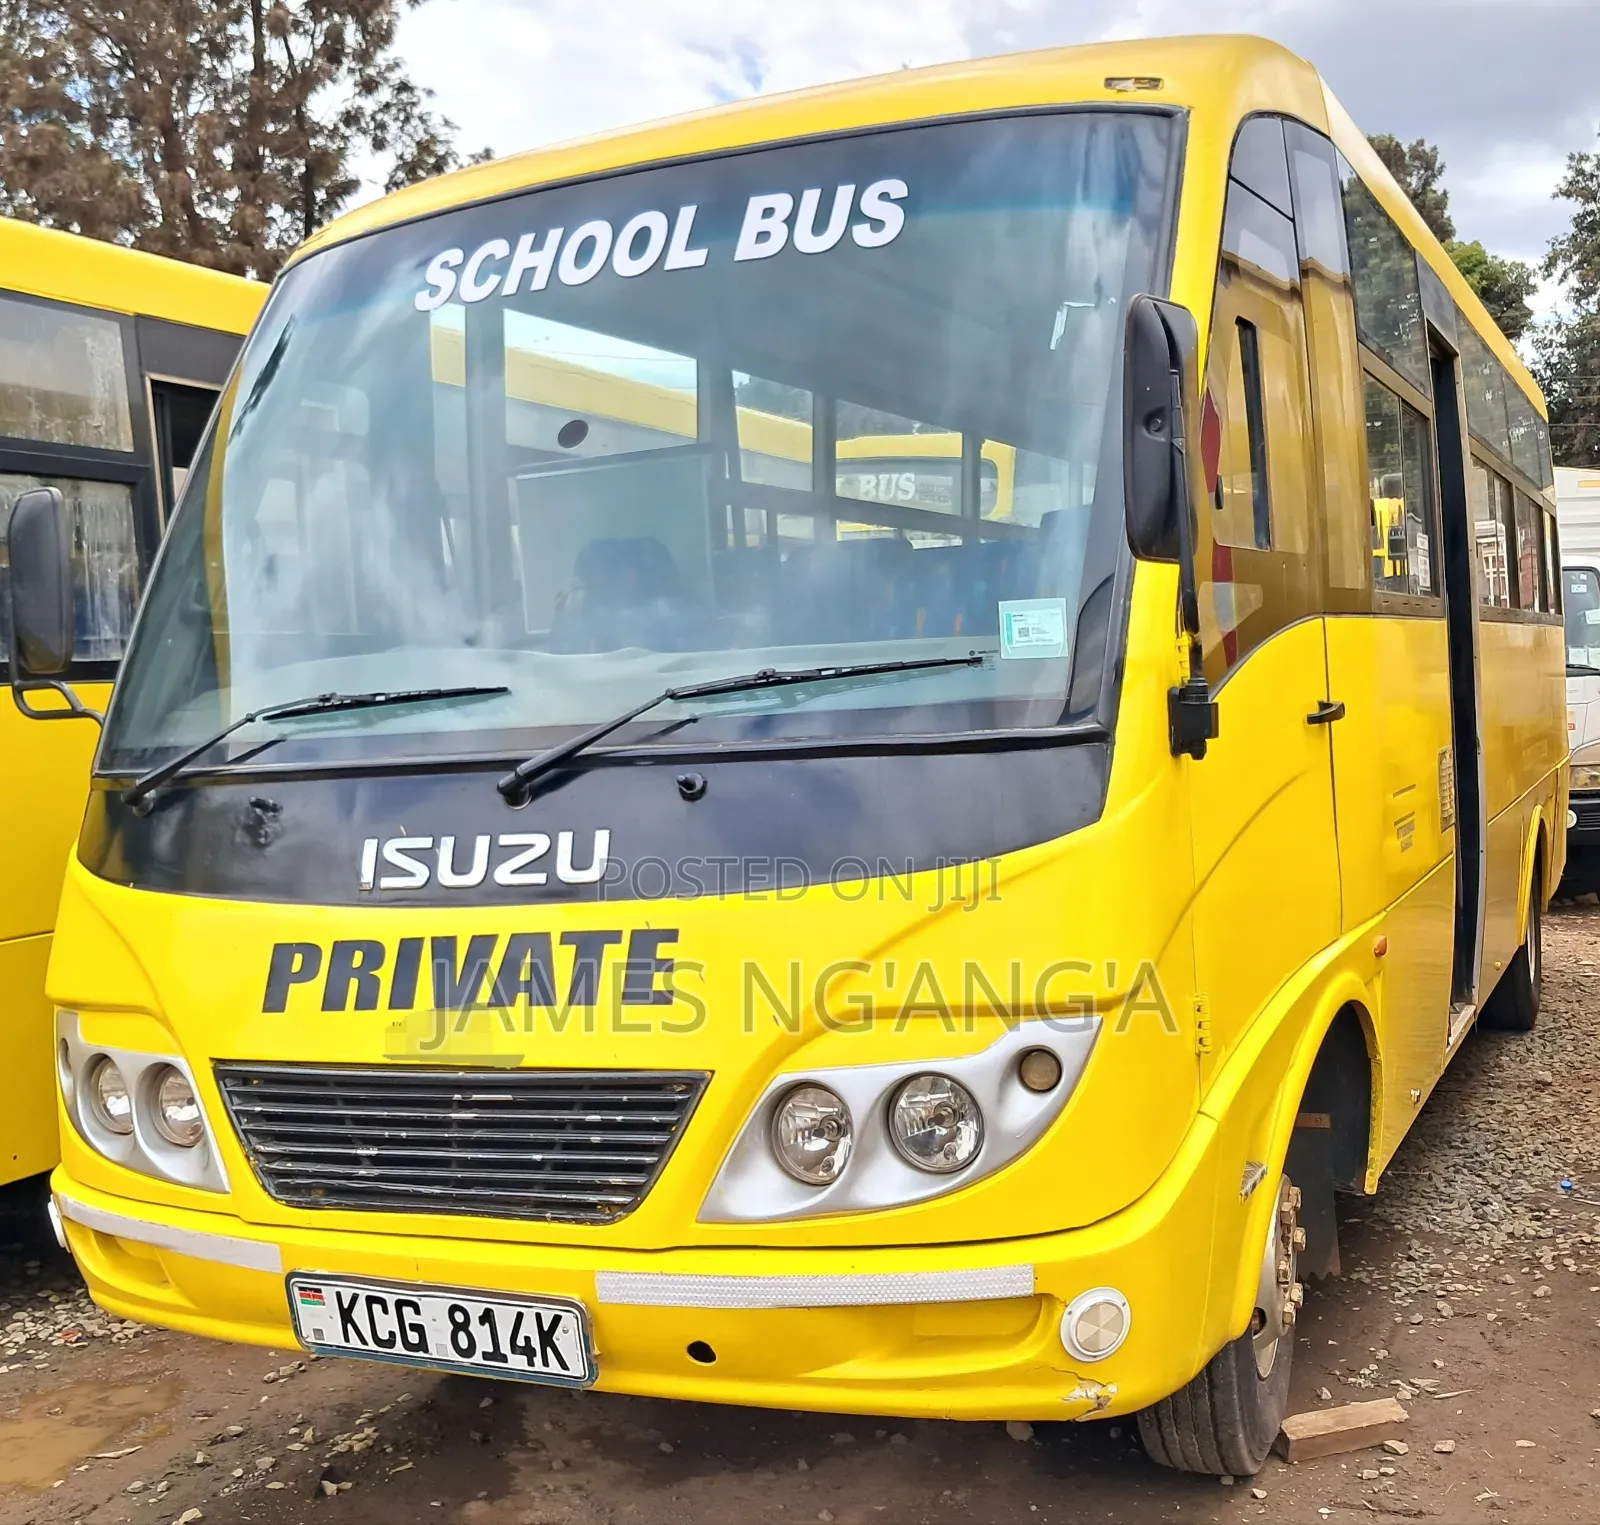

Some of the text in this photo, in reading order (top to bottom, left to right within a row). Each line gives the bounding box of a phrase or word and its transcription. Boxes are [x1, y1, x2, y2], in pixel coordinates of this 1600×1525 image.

[415, 179, 909, 312] SCHOOL BUS
[858, 472, 915, 501] BUS
[359, 828, 611, 891] ISUZU
[261, 928, 679, 1014] PRIVATE
[335, 1291, 570, 1371] KCG 814K
